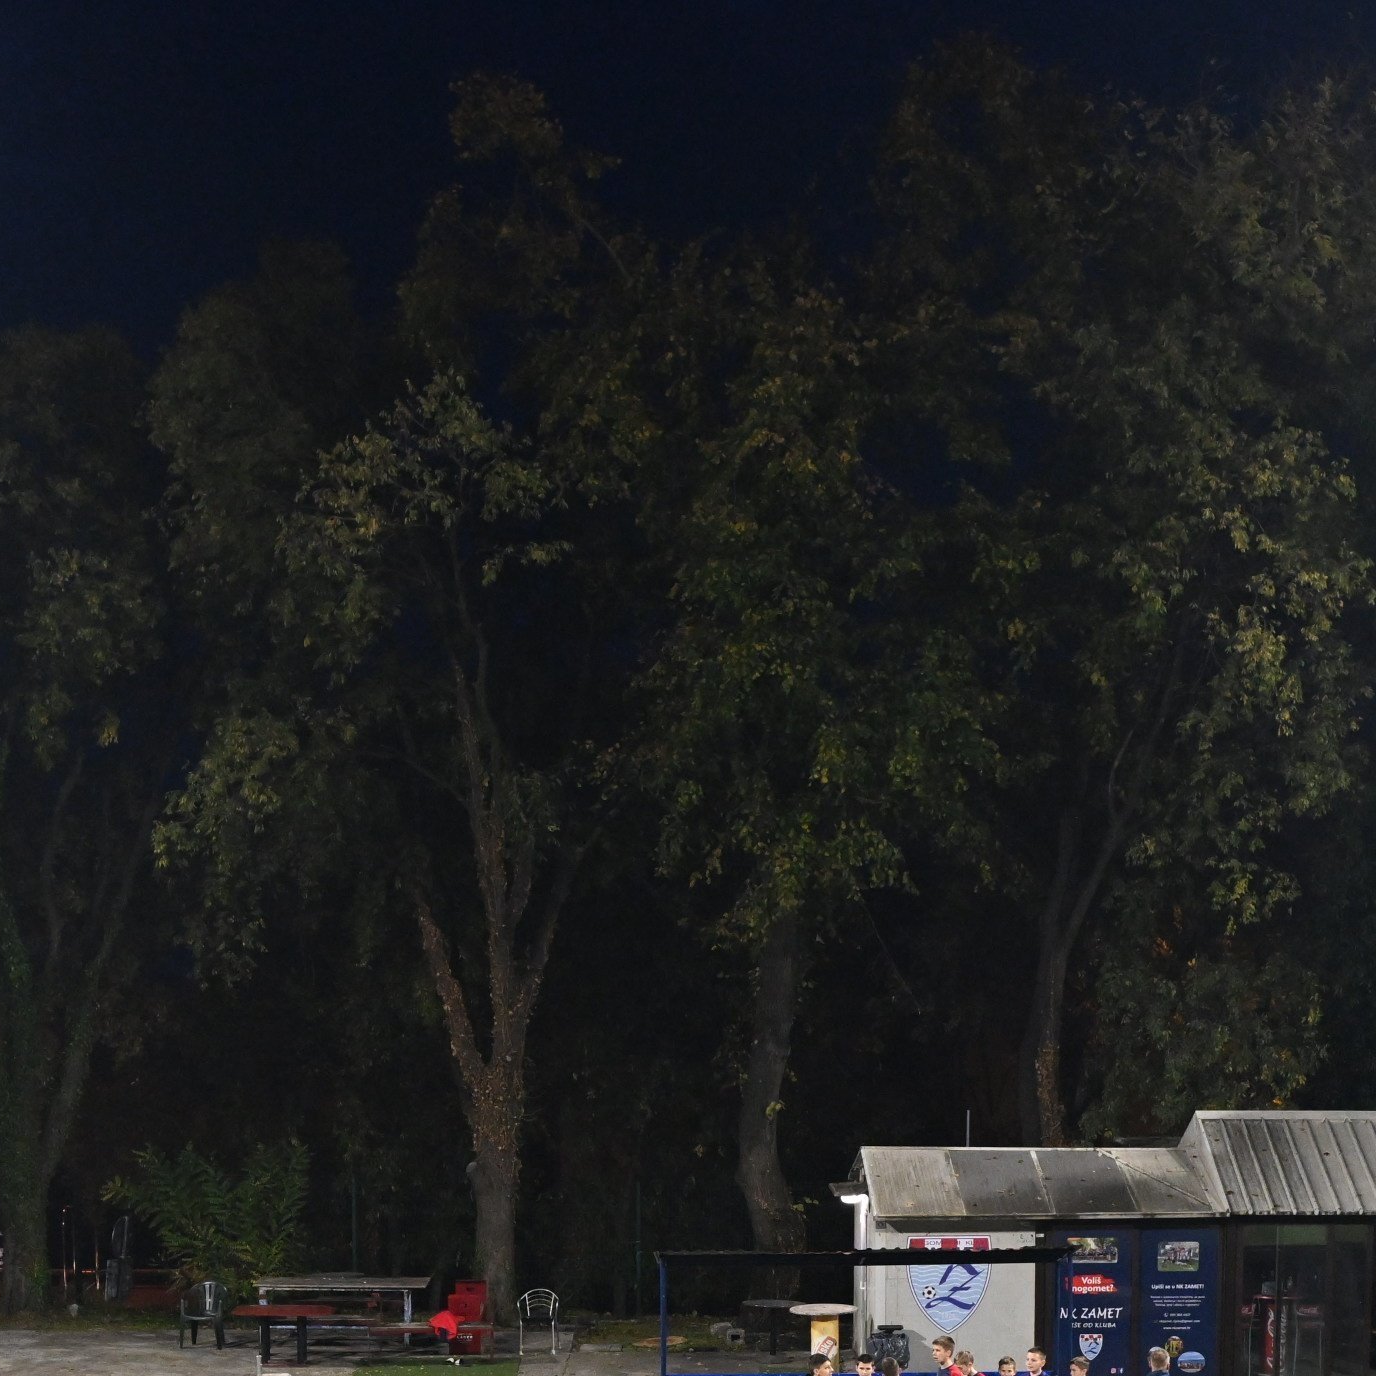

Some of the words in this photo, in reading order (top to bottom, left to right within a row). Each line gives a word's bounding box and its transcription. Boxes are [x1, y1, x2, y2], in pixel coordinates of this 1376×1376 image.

[1081, 1276, 1102, 1285] Voliš
[1071, 1284, 1114, 1294] nogomet?
[1081, 1307, 1123, 1319] ZAMET
